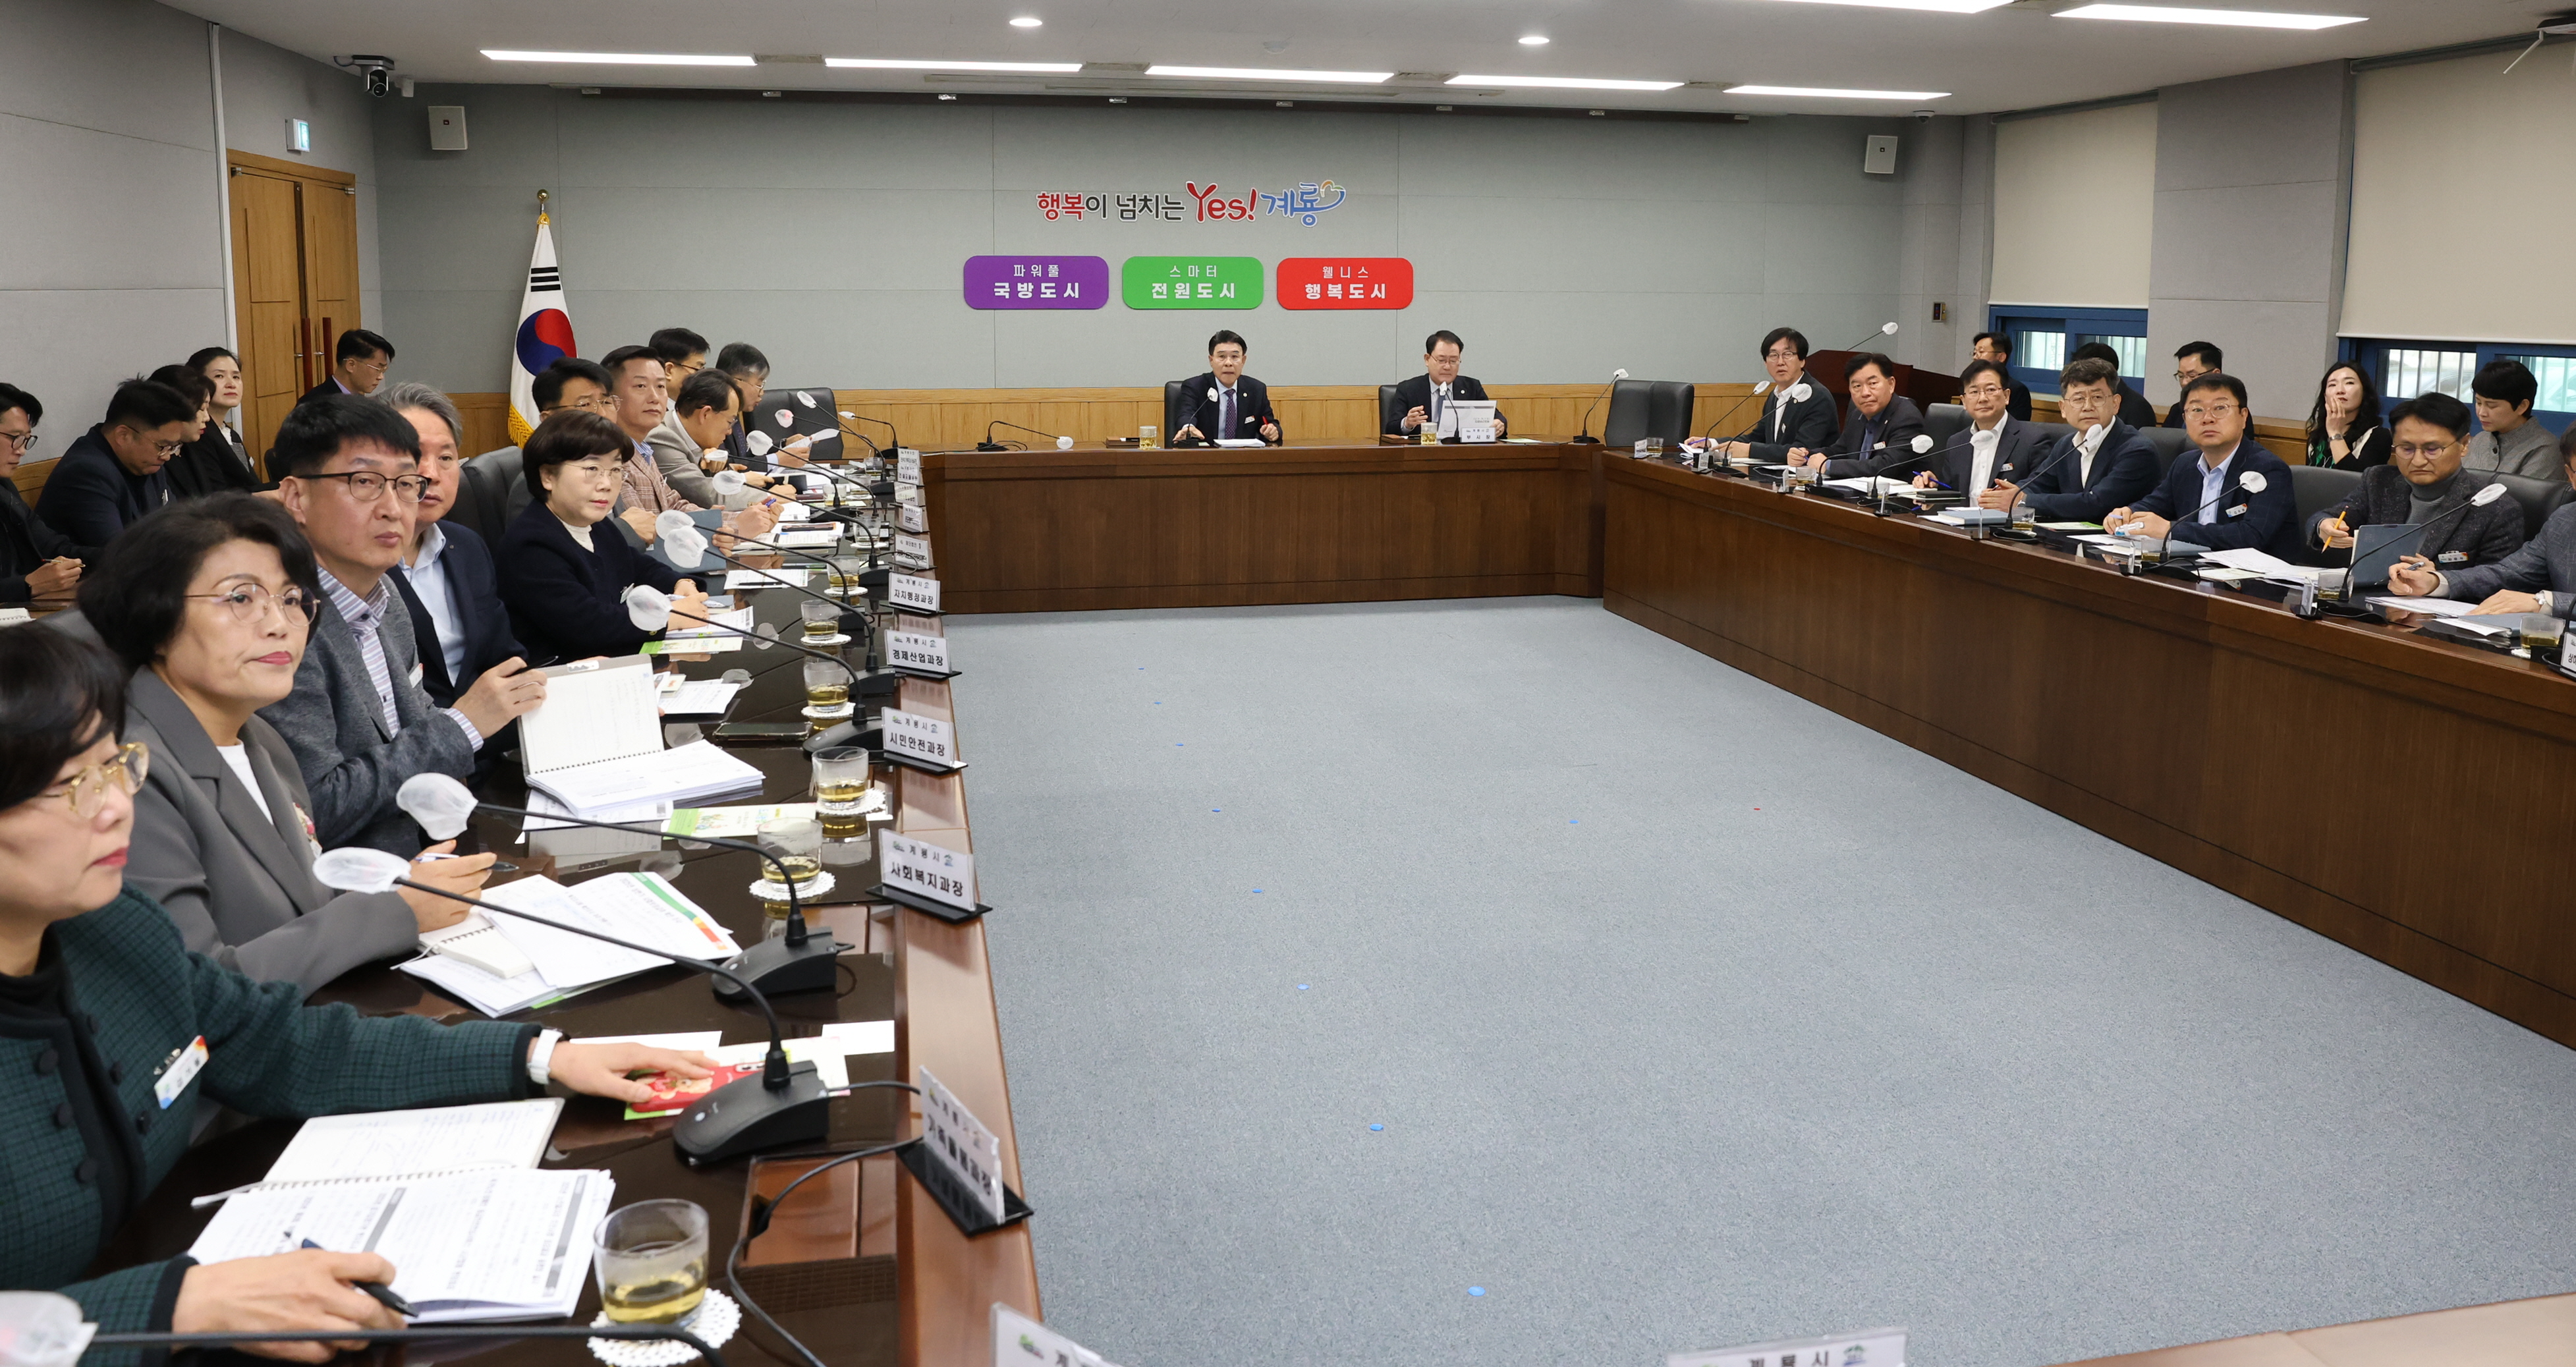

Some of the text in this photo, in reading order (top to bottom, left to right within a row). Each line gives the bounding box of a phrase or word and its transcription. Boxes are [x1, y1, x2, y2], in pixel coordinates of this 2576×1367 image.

[1036, 181, 1345, 227] 행복이 넘치는 Yes! 계룡
[1013, 264, 1059, 277] 파워풀
[1169, 265, 1218, 278] 스마터
[1322, 266, 1369, 279] 웰니스
[994, 282, 1080, 299] 국방도시
[1152, 283, 1235, 299] 전원도시
[1305, 283, 1386, 300] 행복도시
[894, 588, 934, 605] 자치행정과장
[893, 649, 943, 667] 경제산업과장
[889, 732, 945, 757] 시민안전과장
[891, 861, 963, 897] 사회복지과장
